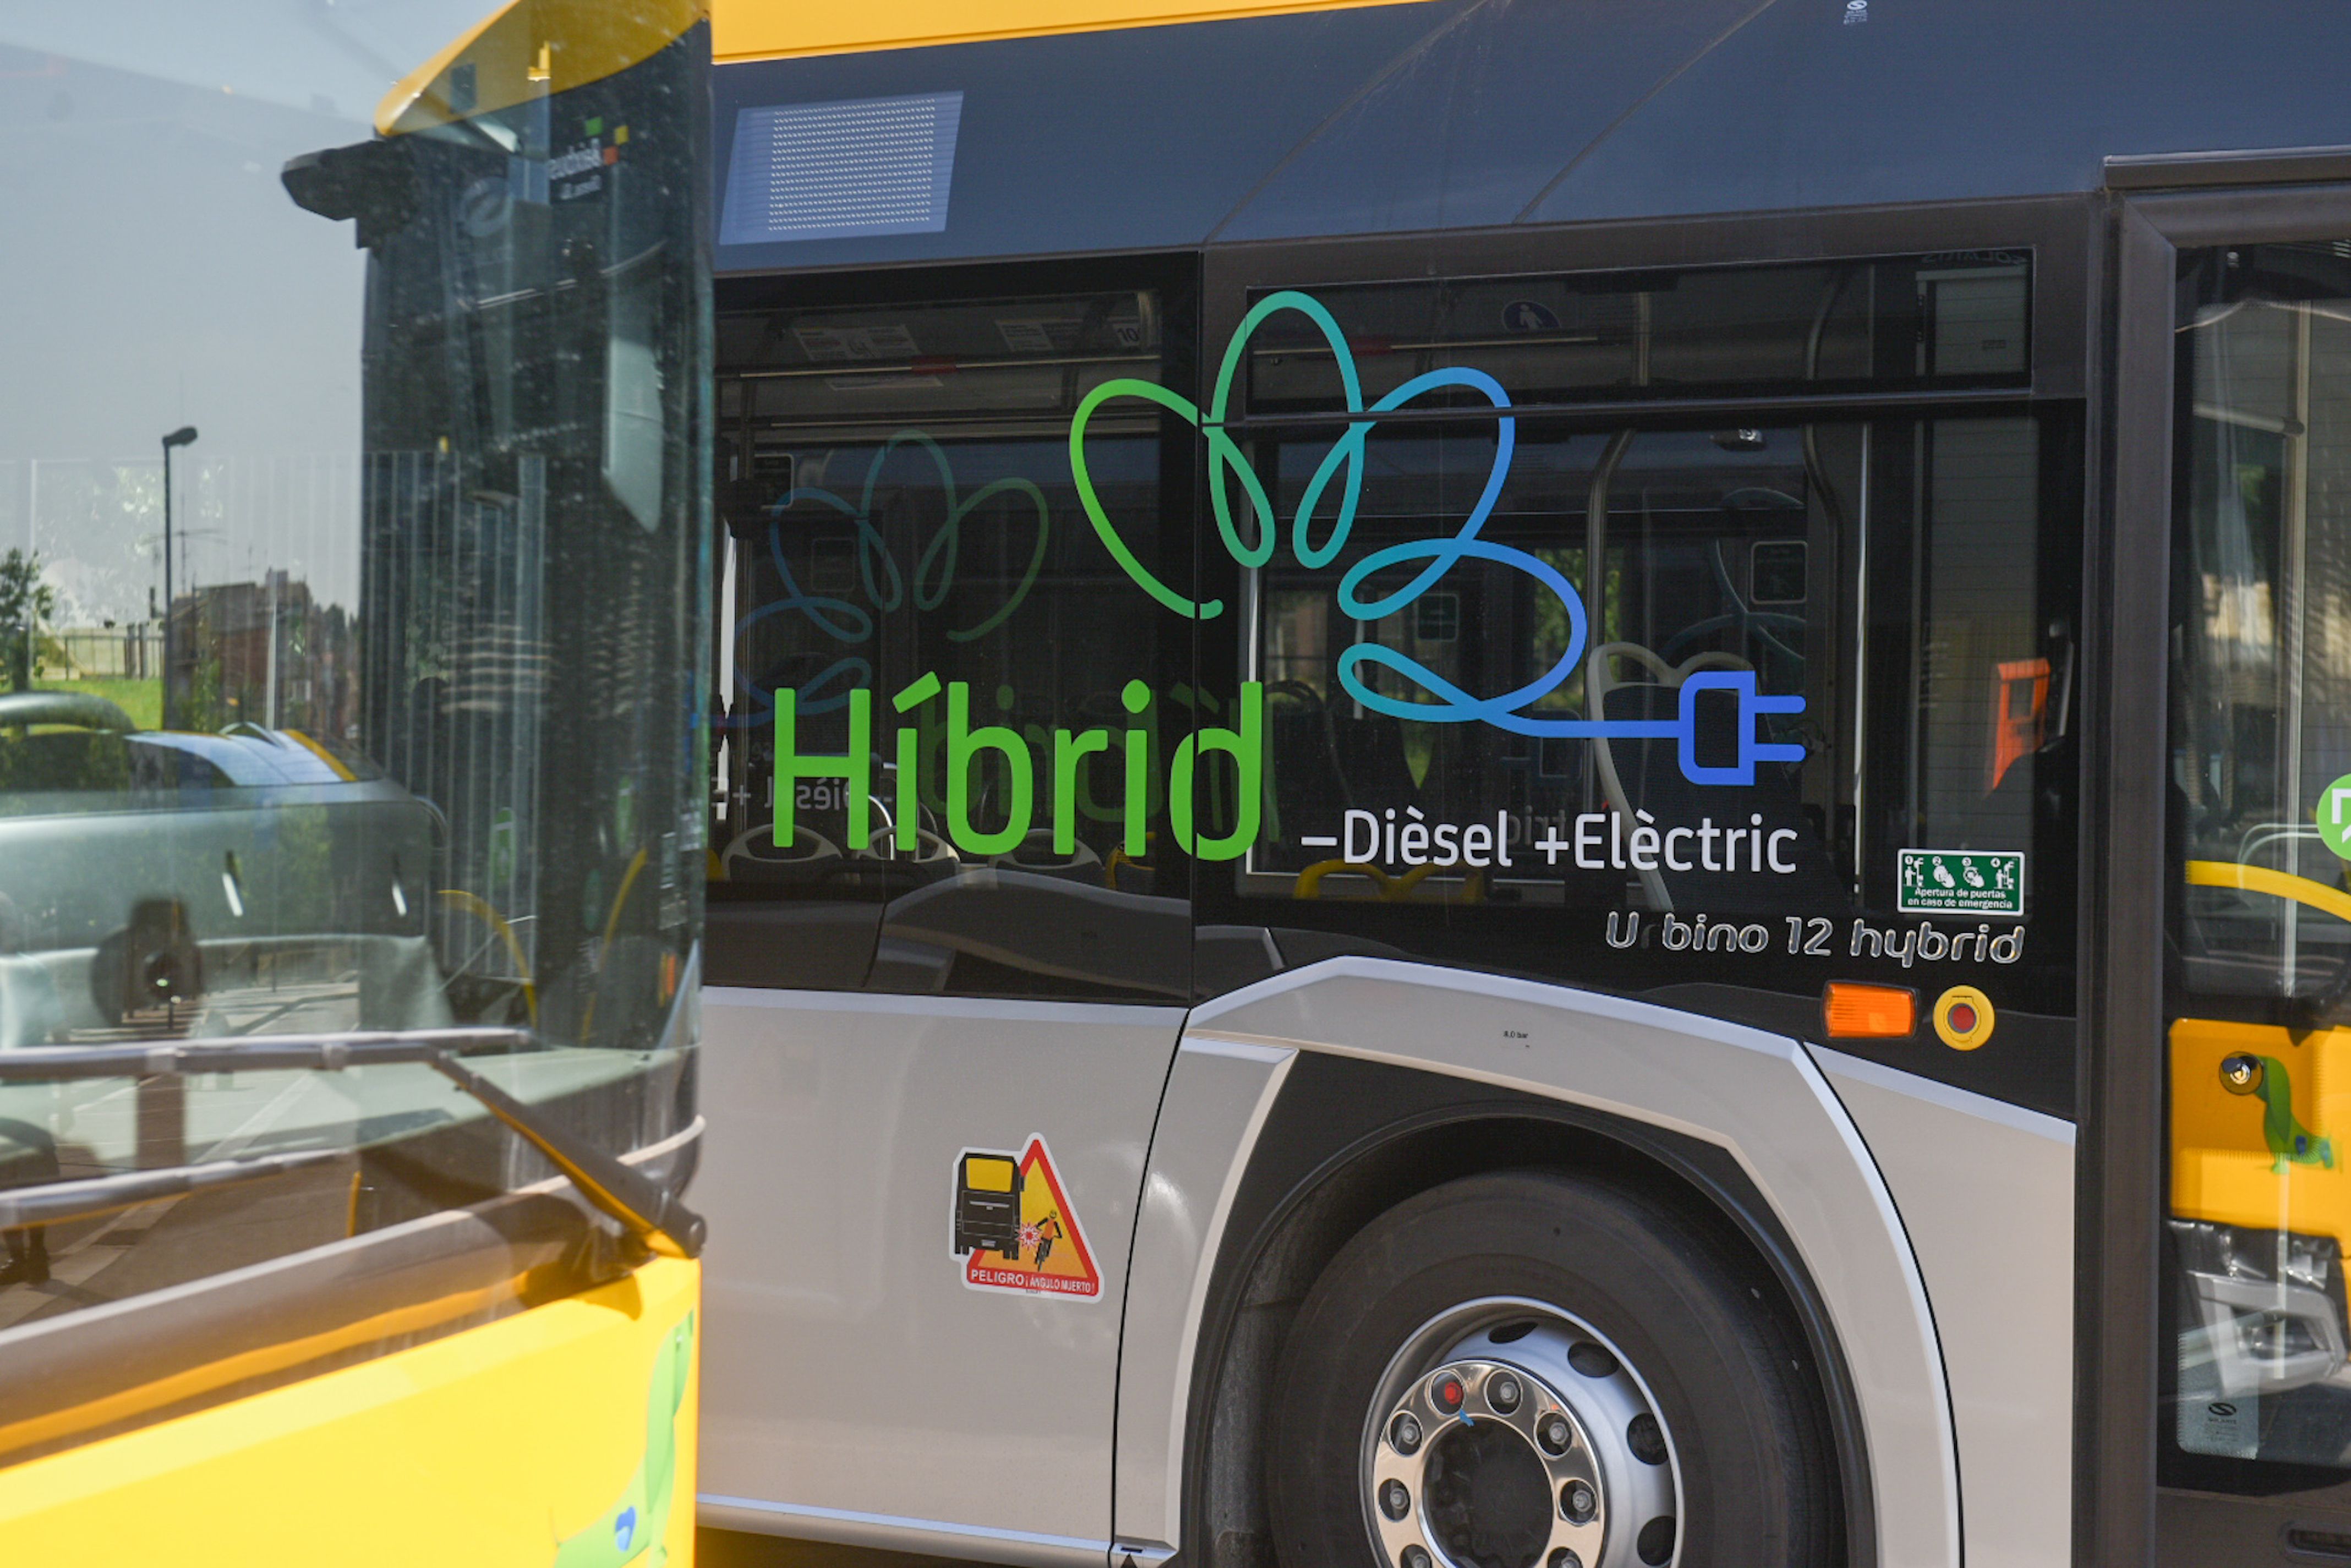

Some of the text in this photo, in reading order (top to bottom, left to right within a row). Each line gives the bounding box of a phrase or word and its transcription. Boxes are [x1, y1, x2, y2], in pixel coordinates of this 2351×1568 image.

[773, 671, 1262, 861] Híbrid
[1915, 887, 2006, 899] Apertura de puertas
[1921, 898, 1943, 906] caso
[1944, 898, 1956, 907] de
[1958, 899, 2013, 909] emergencia
[1786, 916, 1834, 957] 12
[1850, 917, 2025, 969] hybrid
[971, 1269, 1025, 1286] PELIGRO
